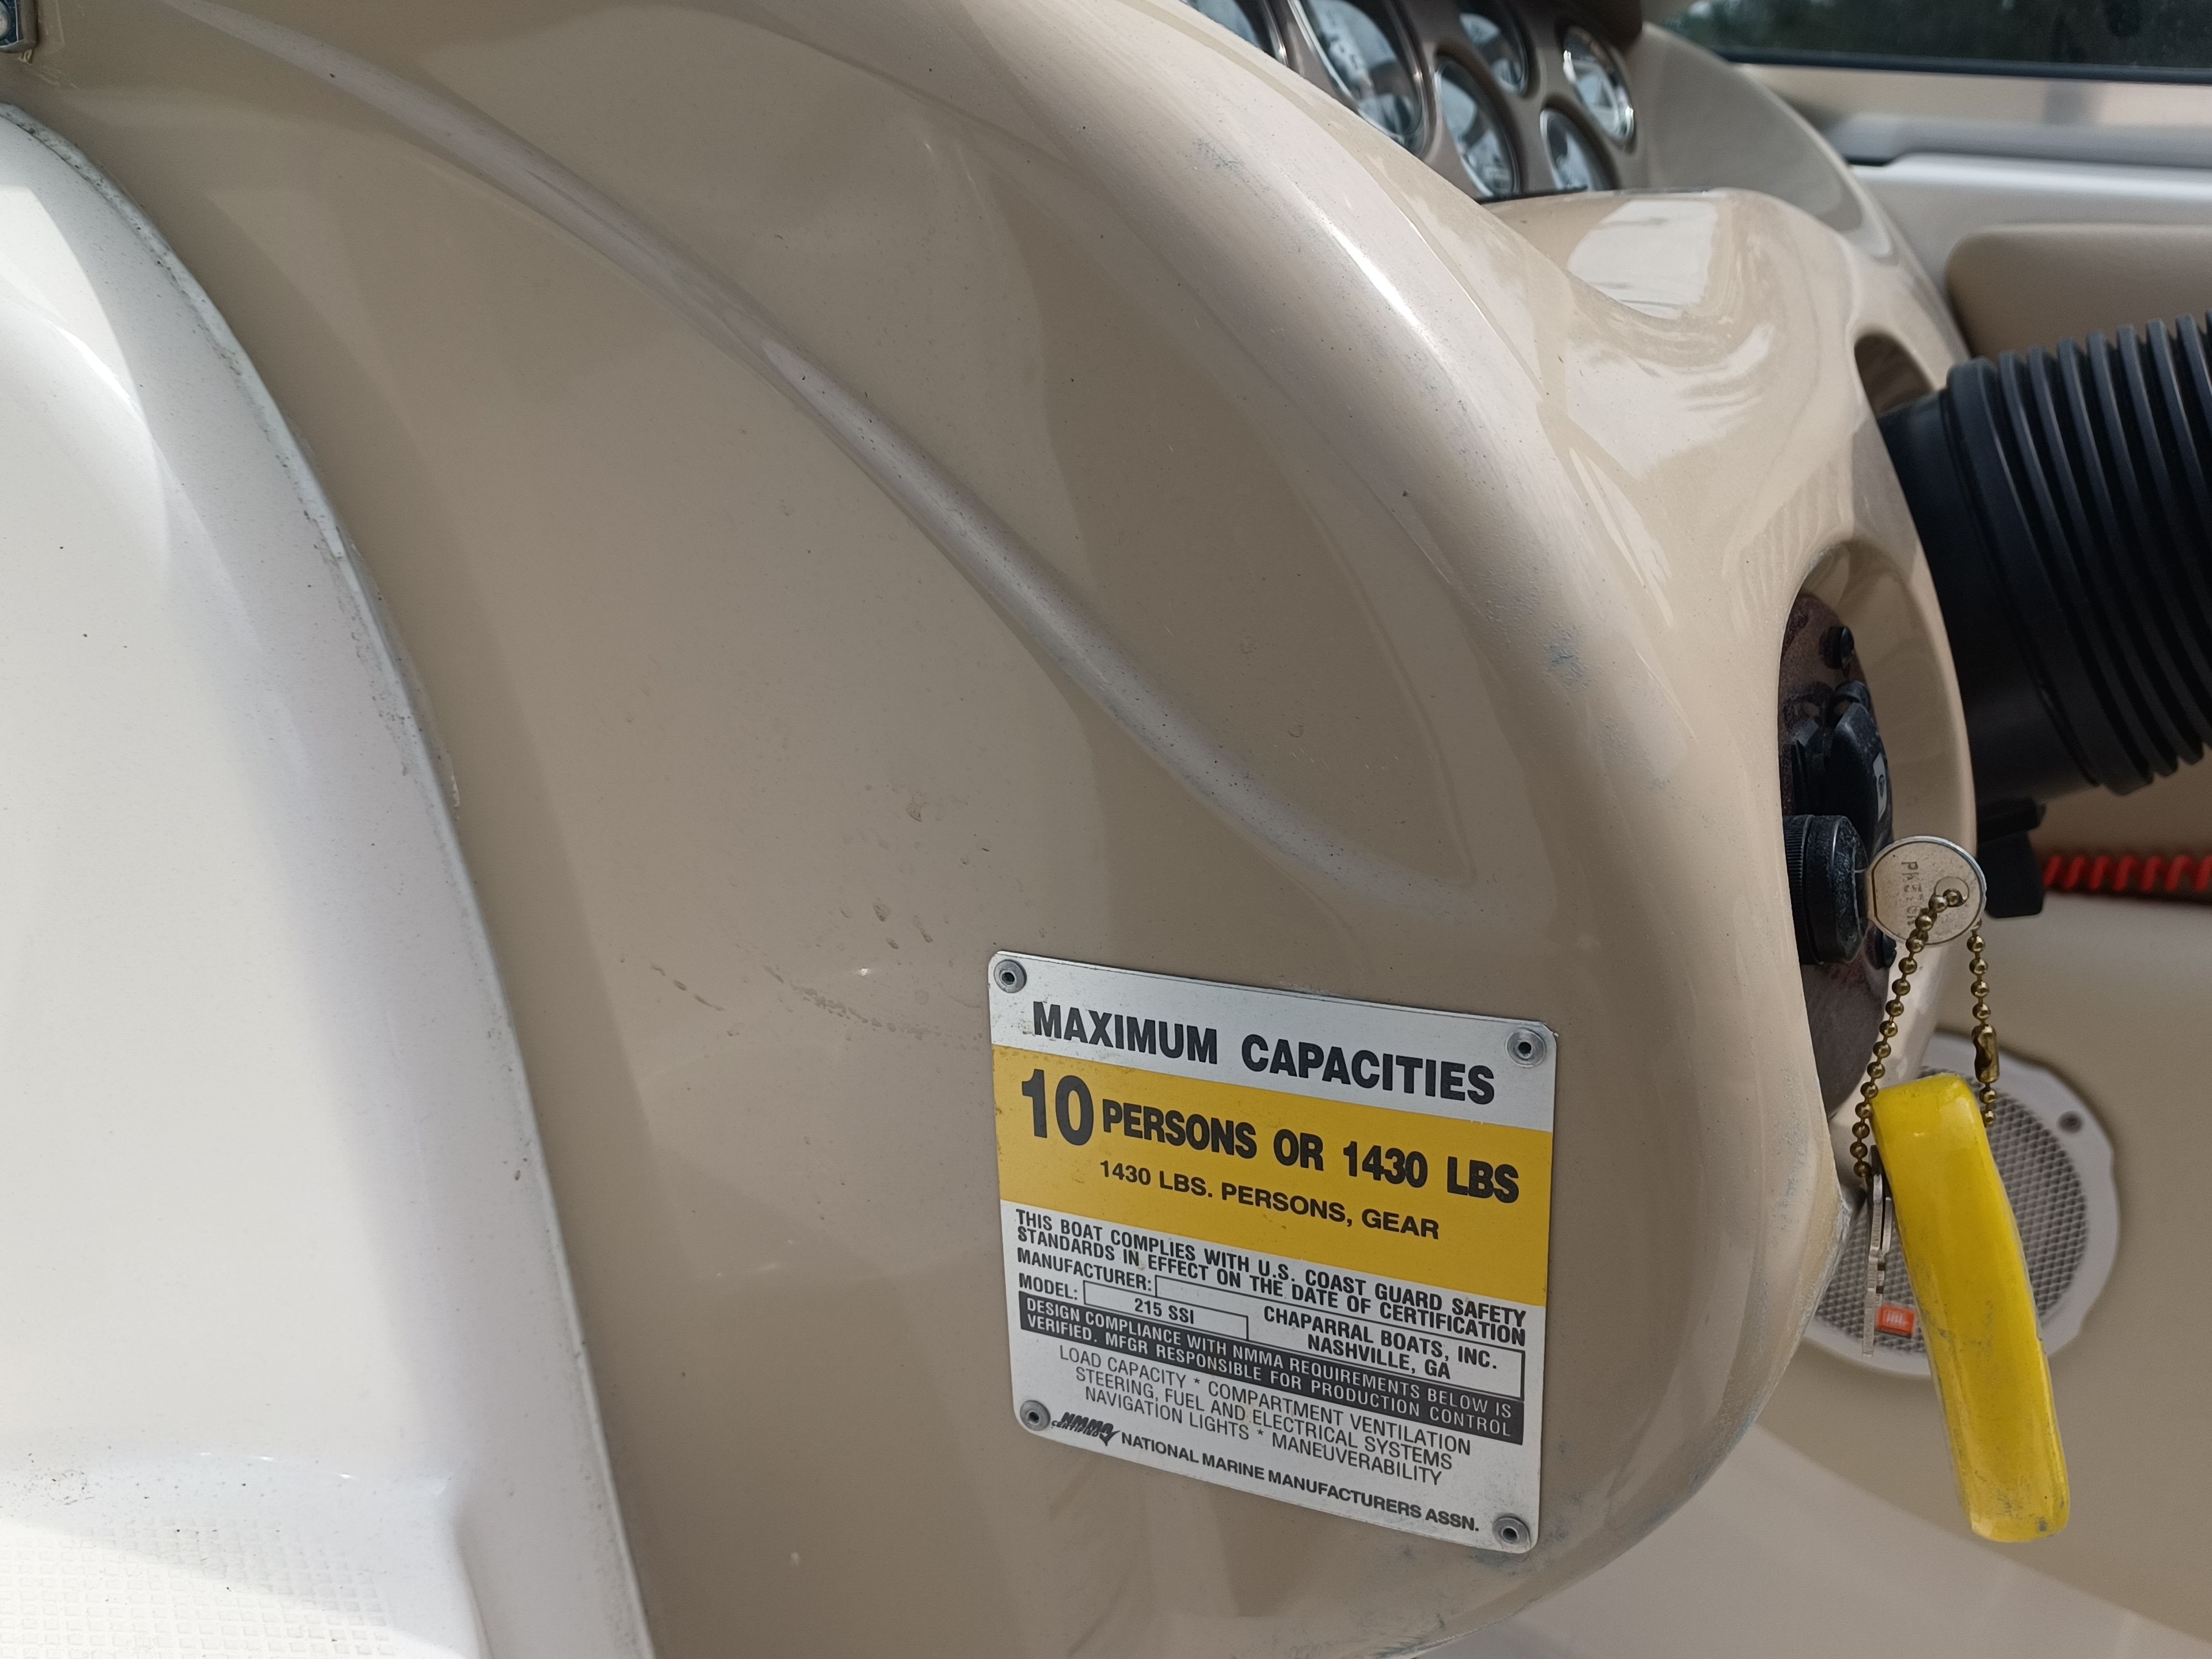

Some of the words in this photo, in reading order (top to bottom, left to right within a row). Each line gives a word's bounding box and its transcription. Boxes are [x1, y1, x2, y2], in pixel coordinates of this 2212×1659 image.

[1033, 1001, 1217, 1065] MAXIMUM
[1241, 1034, 1494, 1104] CAPACITIES
[1021, 1068, 1094, 1145] 10
[1103, 1099, 1257, 1159] PERSONS
[1274, 1129, 1323, 1171] OR
[1343, 1141, 1428, 1188] 1430
[1447, 1156, 1519, 1203] LBS
[1100, 1160, 1151, 1185] 1430
[1160, 1171, 1212, 1197] LBS.
[1222, 1182, 1352, 1227] PERSONS,
[1362, 1209, 1439, 1239] GEAR
[1016, 1209, 1052, 1230] THIS
[1061, 1219, 1102, 1241] BOAT
[1111, 1230, 1195, 1261] COMPLIES
[1204, 1249, 1249, 1272] WITH
[1259, 1260, 1295, 1281] U.S.
[1306, 1269, 1366, 1295] COAST
[1375, 1283, 1442, 1310] GUARD
[1452, 1298, 1526, 1327] SAFETY
[1018, 1247, 1151, 1291] MANUFACTURER:
[1018, 1226, 1114, 1260] STANDARDS
[1124, 1249, 1139, 1266] IN
[1149, 1254, 1208, 1281] EFFECT
[1217, 1272, 1240, 1288] ON
[1249, 1275, 1282, 1297] THE
[1292, 1284, 1338, 1308] DATE
[1347, 1295, 1371, 1314] OF
[1380, 1302, 1525, 1347] CERTIFICATION
[1019, 1272, 1077, 1300] MODEL:
[1135, 1298, 1162, 1317] 215
[1168, 1305, 1193, 1324] SSI
[1027, 1298, 1079, 1321] DESIGN
[1086, 1312, 1181, 1345] COMPLIANCE
[1187, 1335, 1226, 1355] WITH
[1234, 1345, 1283, 1368] NMMA
[1290, 1358, 1419, 1398] REQUIREMENTS
[1428, 1389, 1487, 1413] BELOW
[1496, 1403, 1511, 1418] IS
[1027, 1314, 1097, 1343] VERIFIED.
[1106, 1332, 1147, 1354] MFGR
[1157, 1344, 1261, 1380] RESPONSIBLE
[1271, 1371, 1301, 1390] FOR
[1312, 1380, 1418, 1416] PRODUCTION
[1430, 1406, 1511, 1436] CONTROL
[1264, 1306, 1373, 1343] CHAPARRAL
[1381, 1330, 1448, 1361] BOATS,
[1458, 1346, 1496, 1369] INC.
[1308, 1334, 1415, 1374] NASHVILLE,
[1425, 1359, 1450, 1379] GA
[1060, 1345, 1101, 1368] LOAD
[1108, 1357, 1186, 1388] CAPACITY
[1209, 1381, 1343, 1426] COMPARTMENT
[1350, 1414, 1470, 1455] VENTILATION
[1076, 1366, 1158, 1401] STEERING,
[1165, 1388, 1204, 1411] FUEL
[1211, 1400, 1245, 1420] AND
[1253, 1410, 1358, 1448] ELECTRICAL
[1365, 1436, 1452, 1469] SYSTEMS
[1086, 1386, 1182, 1423] NAVIGATION
[1190, 1412, 1249, 1440] LIGHTS
[1272, 1432, 1442, 1485] MANEUVERABILITY
[1122, 1432, 1199, 1463] NATIONAL
[1202, 1453, 1264, 1480] MARINE
[1269, 1470, 1421, 1518] MANUFACTURERS
[1425, 1509, 1479, 1531] ASSN.
